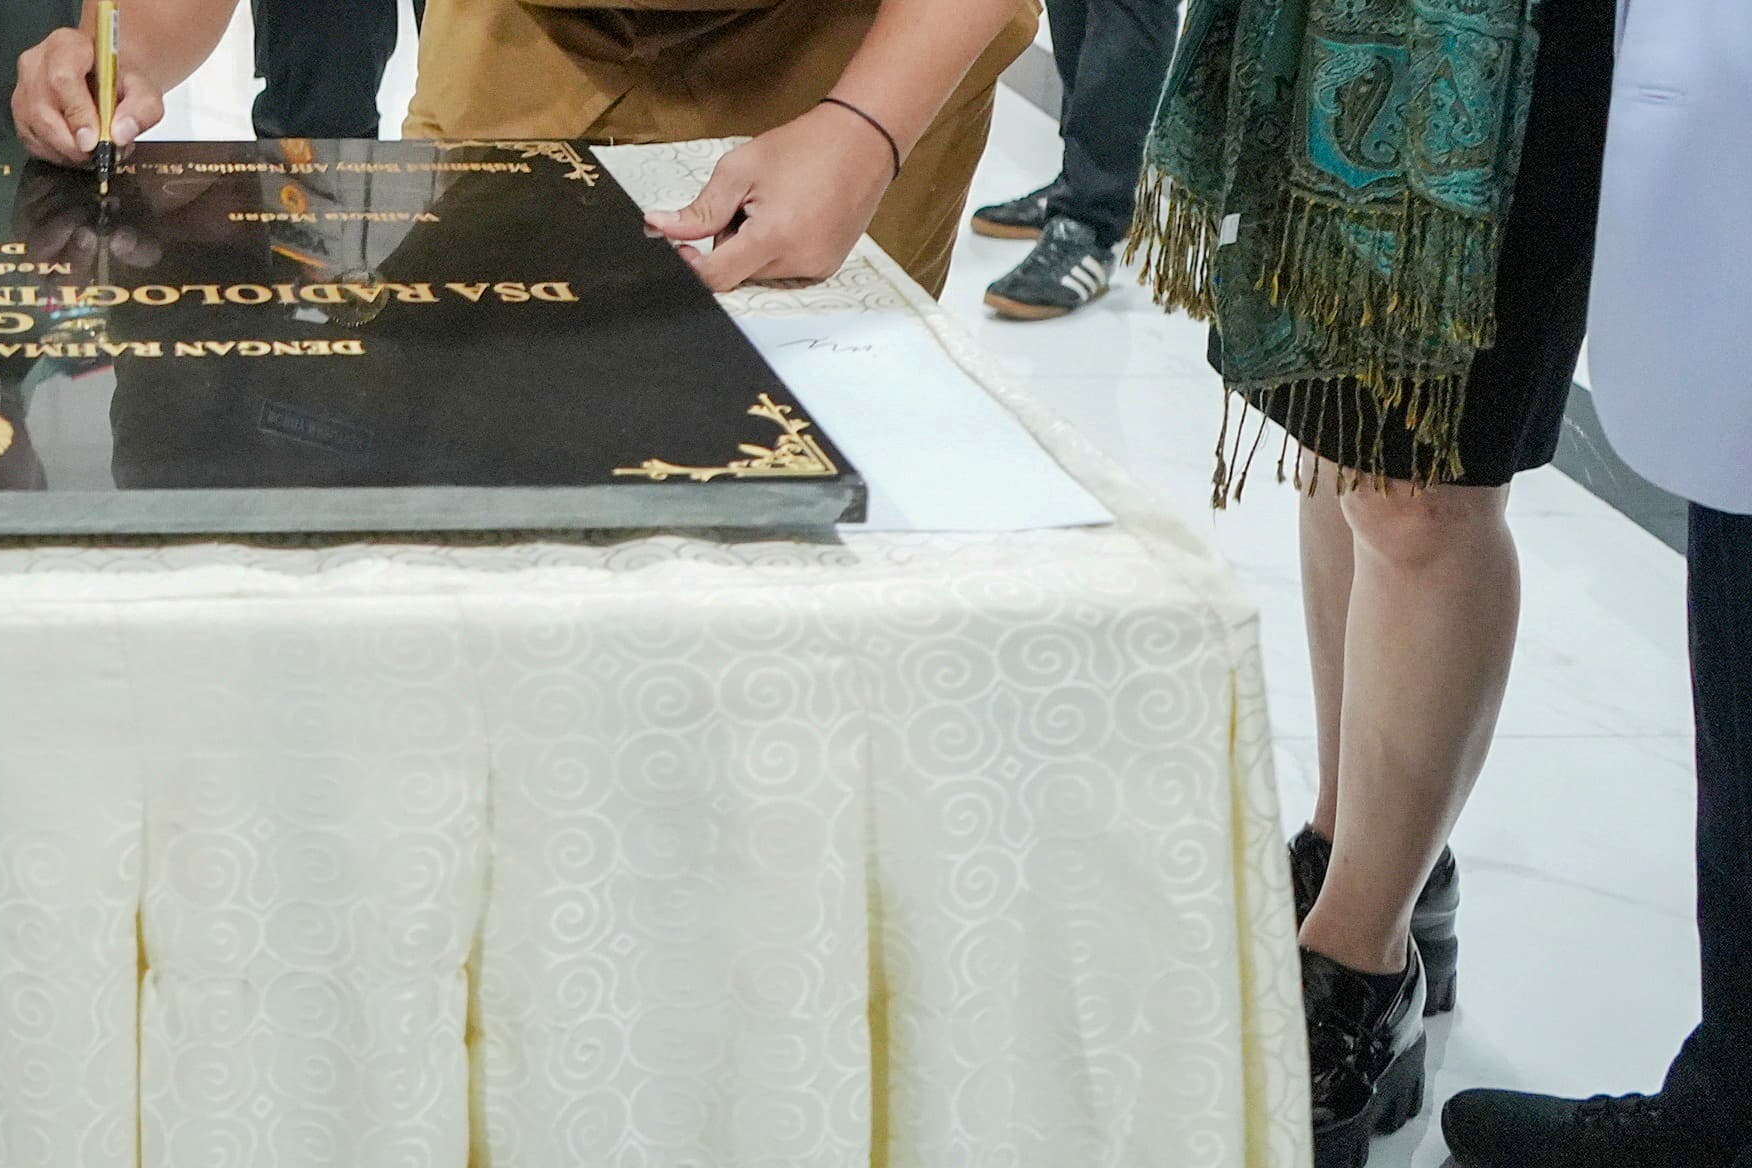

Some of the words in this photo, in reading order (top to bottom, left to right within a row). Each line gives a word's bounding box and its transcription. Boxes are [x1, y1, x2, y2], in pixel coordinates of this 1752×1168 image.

[406, 162, 532, 173] Muhammad
[229, 212, 316, 223] Medan
[325, 212, 440, 223] Walikota
[55, 282, 440, 306] RADIOLOGI
[446, 281, 579, 303] DSA
[174, 340, 366, 356] DENGAN
